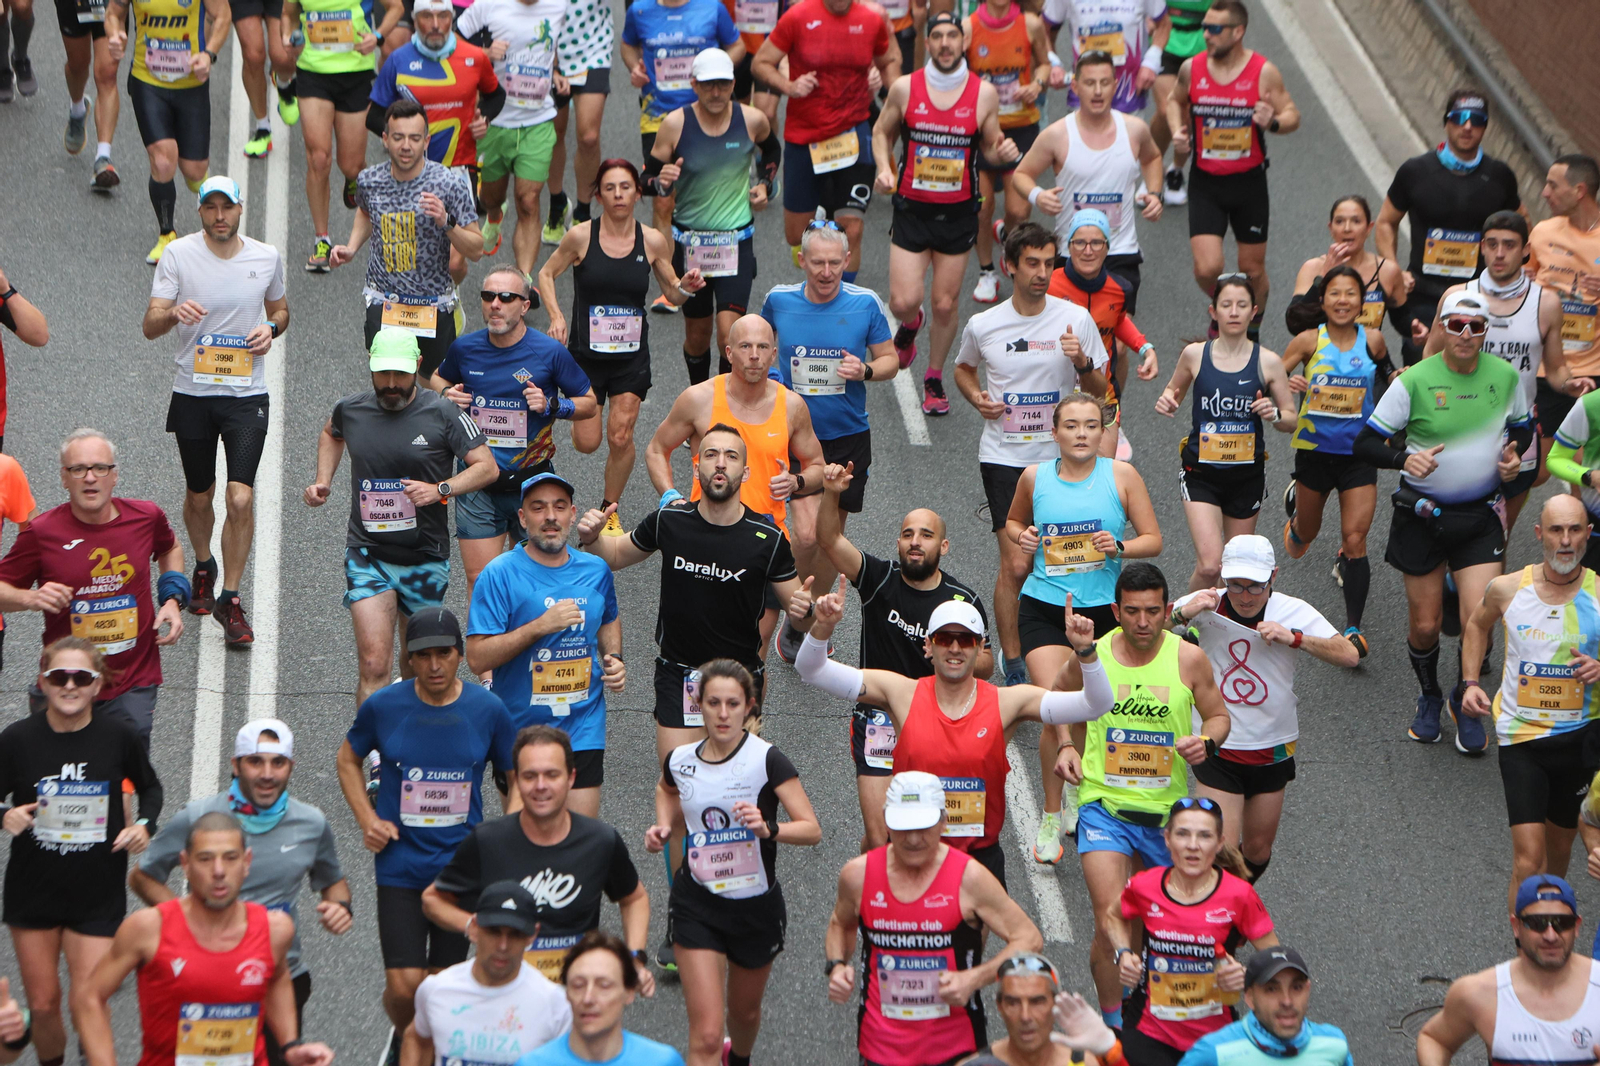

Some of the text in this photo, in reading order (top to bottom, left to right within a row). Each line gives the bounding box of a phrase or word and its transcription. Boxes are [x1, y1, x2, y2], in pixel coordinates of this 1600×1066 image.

[321, 11, 347, 20] ZURICH
[162, 41, 187, 50] ZURICH
[670, 48, 694, 57] ZURICH
[915, 121, 966, 133] atletismo club
[1218, 118, 1244, 127] ZURICH
[931, 149, 959, 158] ZURICH
[1090, 195, 1118, 203] ZURICH
[381, 211, 416, 243] DEATH
[1446, 232, 1476, 241] ZURICH
[703, 238, 732, 247] ZURICH
[382, 242, 418, 273] GLORY
[403, 297, 433, 306] ZURICH
[400, 310, 419, 320] 3705
[216, 337, 248, 347] ZURICH
[609, 335, 625, 343] LOLA
[214, 353, 234, 363] 3998
[809, 348, 841, 358] ZURICH
[215, 366, 232, 376] FRED
[808, 364, 829, 373] 8866
[808, 378, 829, 388] Wattsy
[1331, 376, 1362, 387] ZURICH
[489, 399, 521, 409] ZURICH
[1022, 394, 1053, 405] ZURICH
[488, 414, 509, 425] 7326
[1022, 410, 1042, 421] 7144
[481, 427, 516, 438] FERNANDO
[1019, 424, 1045, 433] ALBERT
[1220, 425, 1250, 434] ZURICH
[1219, 453, 1237, 461] JUDE
[374, 481, 406, 492] ZURICH
[374, 498, 395, 508] 7048
[370, 510, 405, 521] ÓSCAR G R
[1061, 522, 1096, 536] ZURICH
[1062, 541, 1084, 552] 4903
[1064, 555, 1086, 564] EMMA
[88, 547, 135, 584] 25
[674, 556, 747, 582] Daralux
[92, 574, 124, 585] MEDIA
[93, 598, 131, 612] ZURICH
[887, 609, 930, 639] Daralu
[556, 648, 588, 659] ZURICH
[554, 668, 576, 678] 4741
[1541, 667, 1575, 677] ZURICH
[541, 680, 587, 693] ANTONIO JOSÉ
[1539, 684, 1562, 695] 5283
[1111, 697, 1174, 719] eluxe
[1540, 700, 1561, 709] FELIX
[885, 734, 897, 745] 71
[1129, 734, 1167, 745] ZURICH
[870, 747, 893, 757] QUEMA
[1127, 751, 1151, 763] 3900
[427, 771, 466, 781] ZURICH
[1118, 766, 1158, 777] FMPROPIN
[62, 784, 103, 795] ZURICH
[941, 780, 979, 791] ZURICH
[424, 790, 449, 801] 6836
[420, 805, 452, 814] MANUEL
[945, 799, 962, 810] 381
[946, 815, 964, 824] ARIO
[709, 830, 748, 844] ZURICH
[710, 852, 734, 864] 6550
[714, 868, 735, 879] GIULI
[873, 918, 943, 931] atletismo club
[1154, 929, 1216, 944] atletismo club
[537, 936, 577, 949] ZURICH
[1149, 936, 1216, 956] MANCHATHO
[899, 960, 940, 970] ZURICH
[1172, 962, 1214, 974] ZURICH
[900, 979, 925, 991] 7323
[1173, 982, 1197, 992] 4967
[207, 1006, 252, 1018] ZURICH
[471, 1032, 522, 1055] IBIZA
